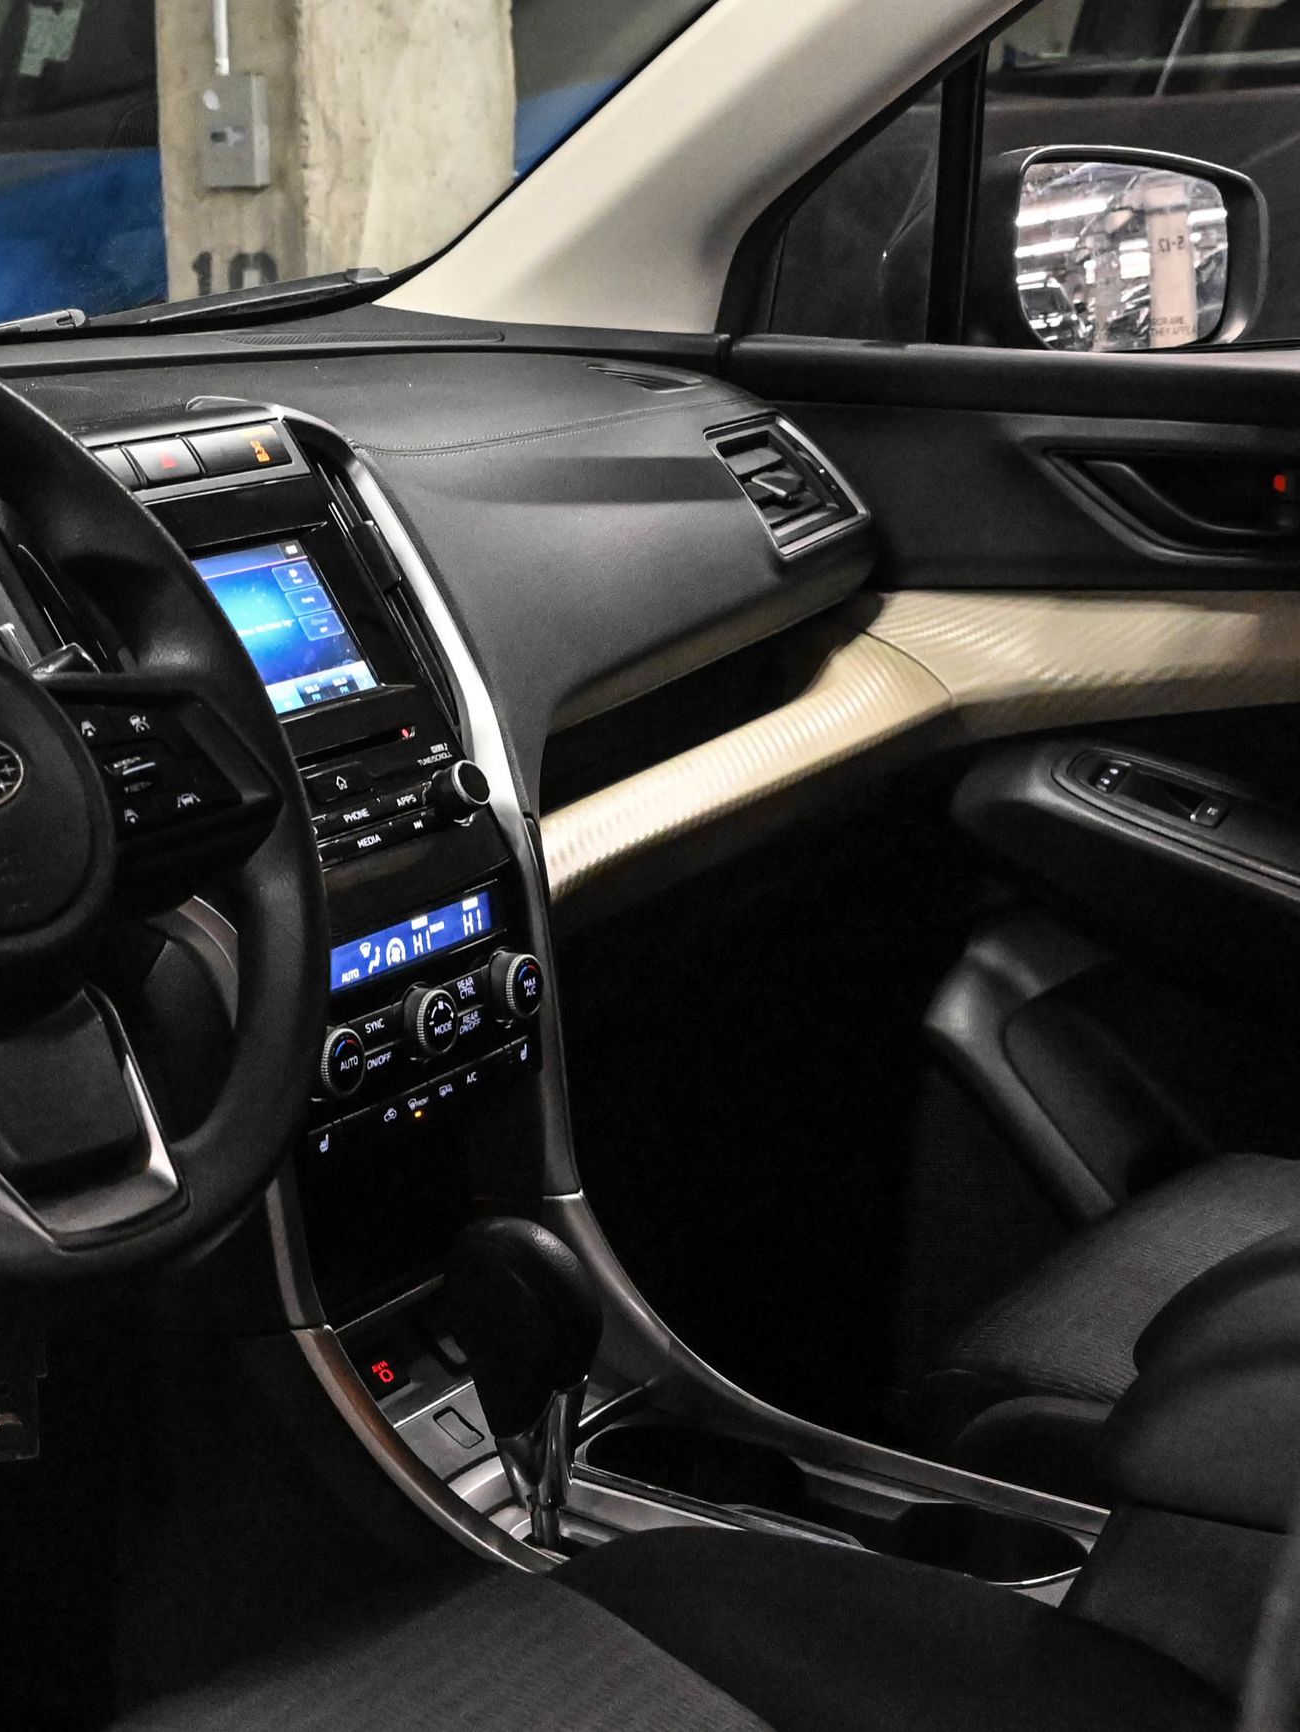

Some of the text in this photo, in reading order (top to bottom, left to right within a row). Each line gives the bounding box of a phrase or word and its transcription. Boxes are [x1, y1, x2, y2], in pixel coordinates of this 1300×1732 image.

[396, 793, 417, 807] APPS
[342, 807, 370, 823] PHONE
[356, 833, 382, 849] MEDIA
[341, 967, 360, 984] AUTO
[456, 976, 475, 991] REAR
[523, 977, 537, 990] MAX
[525, 985, 538, 997] A/C
[459, 987, 476, 1000] CTRL
[462, 1010, 480, 1024] REAR
[364, 1017, 386, 1034] SYNC
[433, 1021, 454, 1036] MODE
[458, 1017, 482, 1035] ON/OFF
[339, 1055, 360, 1071] AUTO
[366, 1051, 392, 1070] ON/OFF
[466, 1071, 477, 1085] A/C
